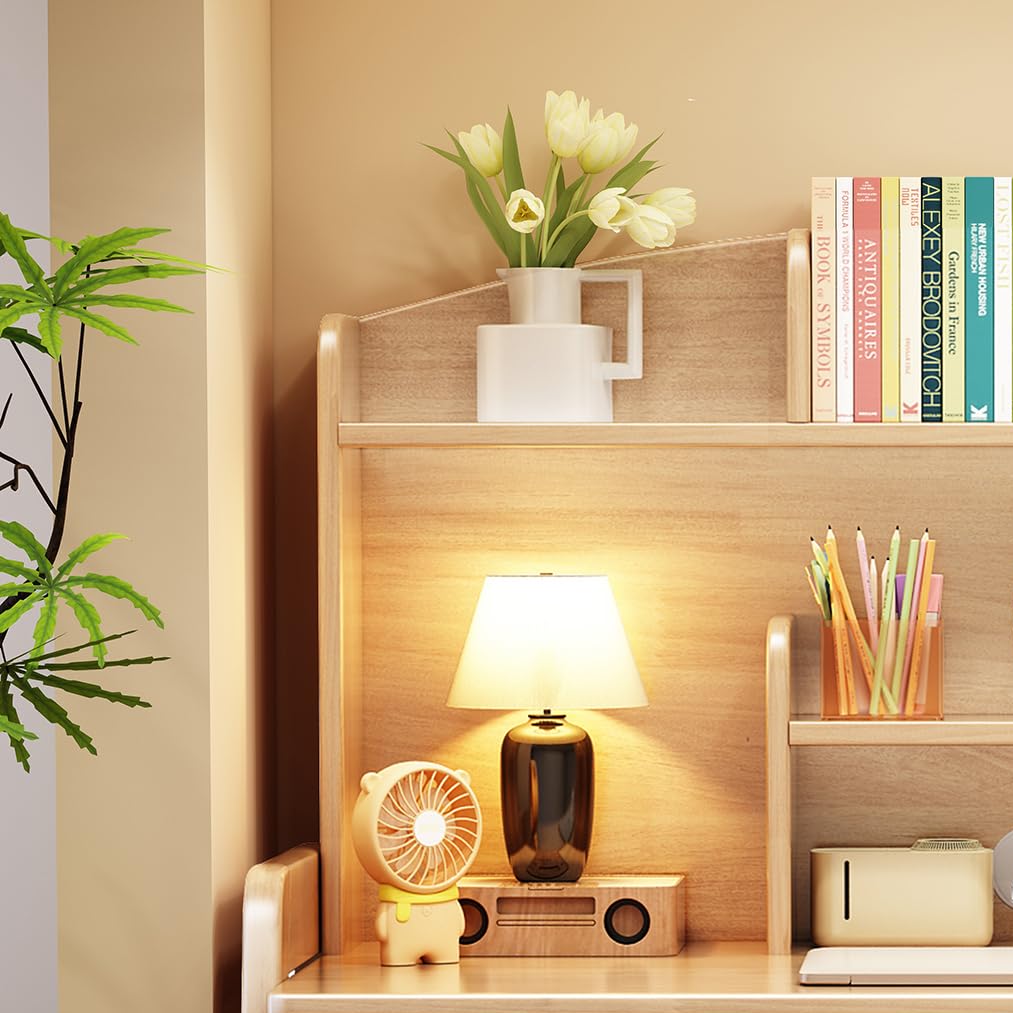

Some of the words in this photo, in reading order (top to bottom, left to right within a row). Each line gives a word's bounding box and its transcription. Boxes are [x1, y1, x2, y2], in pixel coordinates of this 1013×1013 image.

[842, 190, 850, 228] FORMULA
[911, 188, 920, 227] TEXTILES
[922, 182, 941, 265] ALEXEY
[842, 236, 850, 265] WORLD
[970, 223, 978, 246] HILARY
[978, 223, 987, 244] NEW
[817, 236, 831, 284] BOOK
[948, 251, 960, 299] Gardens
[970, 247, 978, 274] FRENCH
[978, 245, 987, 275] URBAN
[842, 266, 850, 312] CHAMPIONS
[861, 239, 878, 360] ANTIQUAIRES
[948, 301, 960, 313] in
[978, 276, 987, 317] HOUSING
[817, 303, 831, 388] SYMBOLS
[922, 271, 941, 407] BRODOVITCH
[948, 316, 960, 355] France
